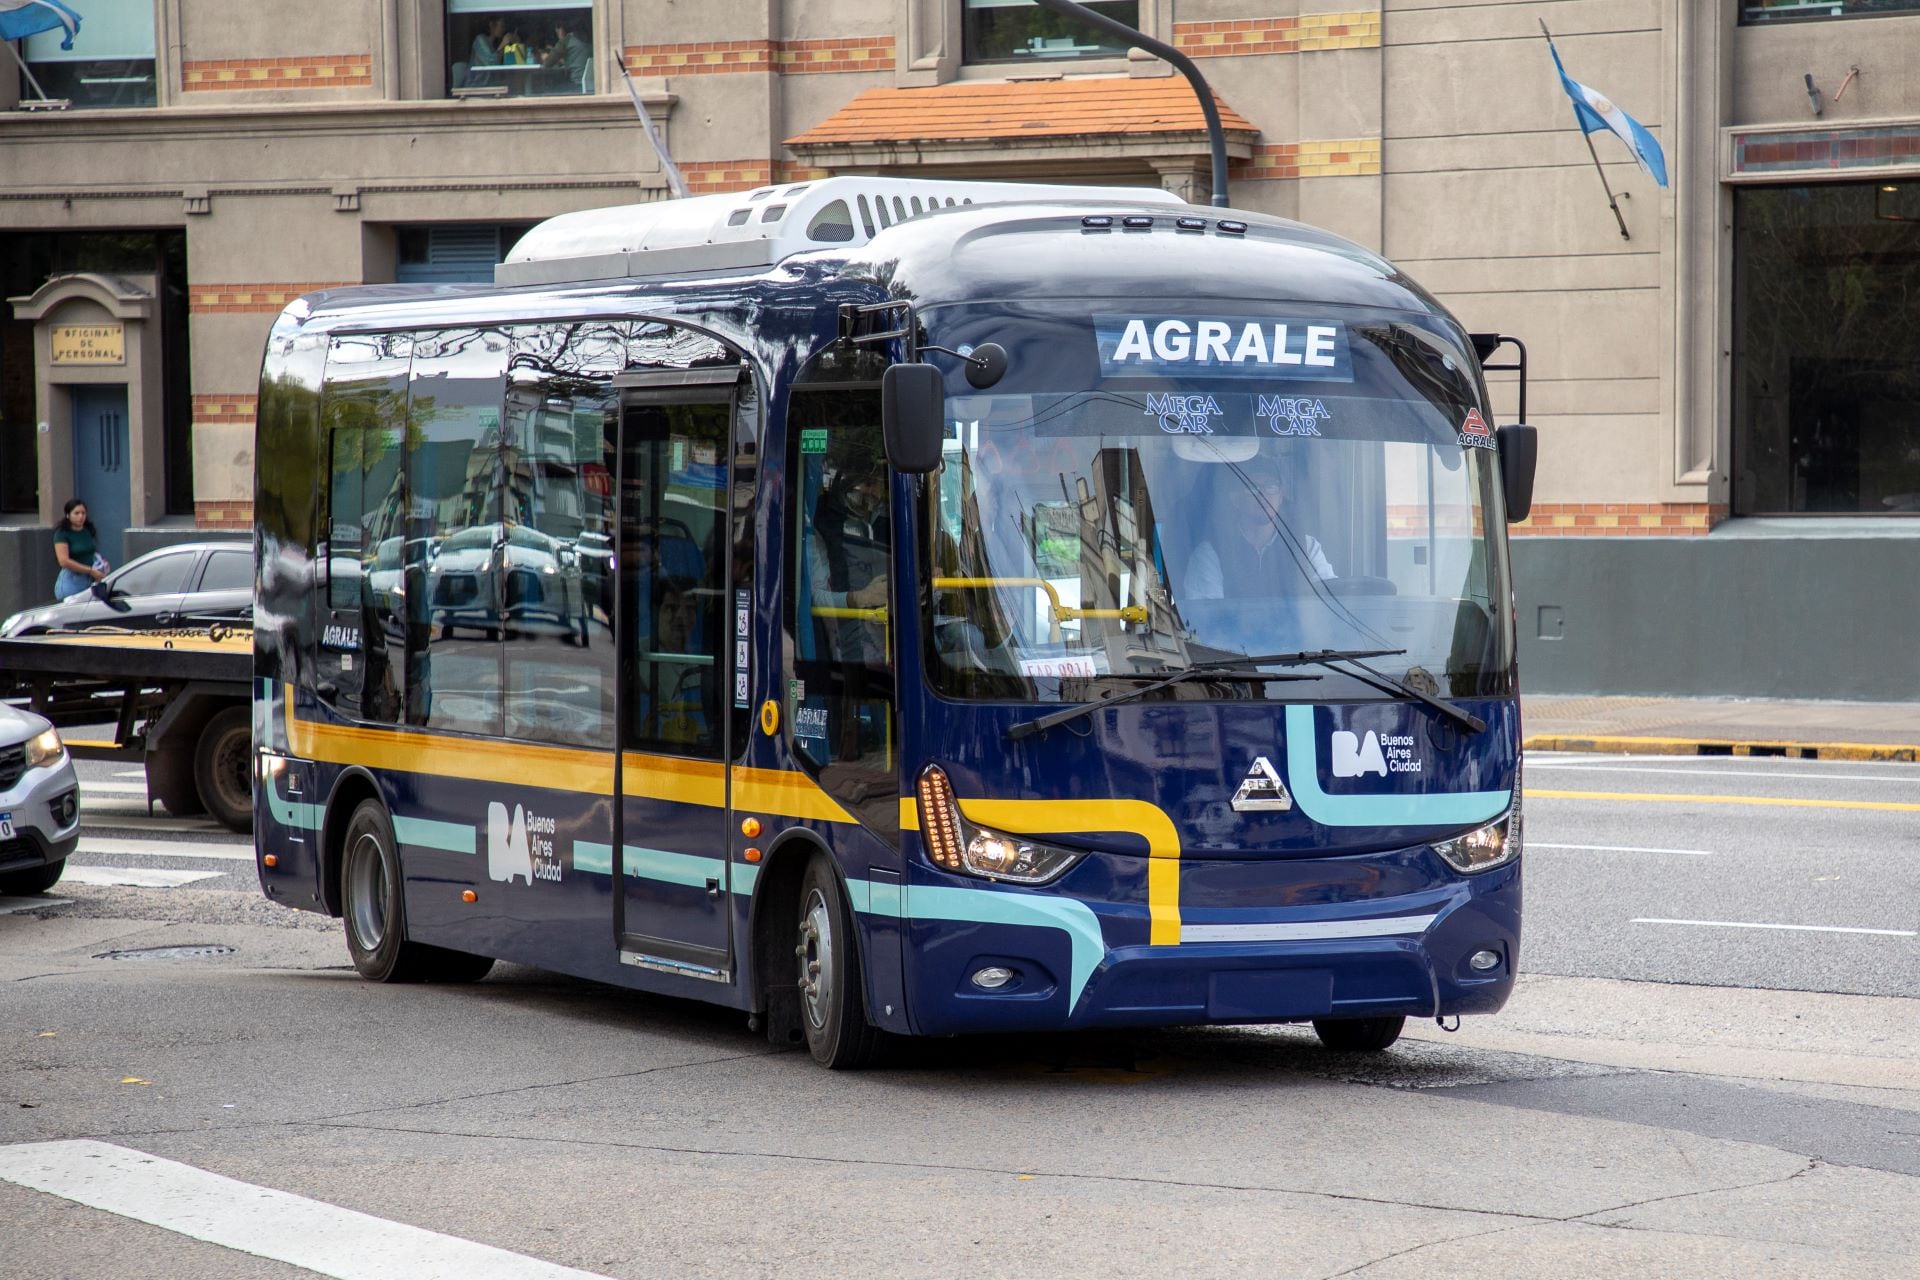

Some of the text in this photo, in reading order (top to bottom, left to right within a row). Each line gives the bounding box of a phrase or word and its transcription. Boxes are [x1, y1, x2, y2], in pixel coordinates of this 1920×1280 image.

[64, 329, 109, 338] OFICINA
[80, 340, 93, 348] DE
[1113, 319, 1337, 367] AGRALE
[58, 350, 117, 358] PERSONAL
[1144, 392, 1224, 416] MEGA
[1256, 394, 1331, 418] MEGA
[1158, 412, 1214, 434] CAR
[1270, 414, 1322, 436] CAR
[1456, 432, 1497, 451] AGRALE
[322, 625, 359, 648] AGRALE
[1380, 733, 1414, 746] Buenos
[1331, 729, 1388, 778] BA
[1386, 746, 1411, 759] Aires
[1389, 759, 1422, 773] Ciudad
[527, 810, 555, 835] Buenos
[487, 801, 533, 887] BA
[531, 834, 553, 857] Aires
[534, 857, 562, 882] Ciudad
